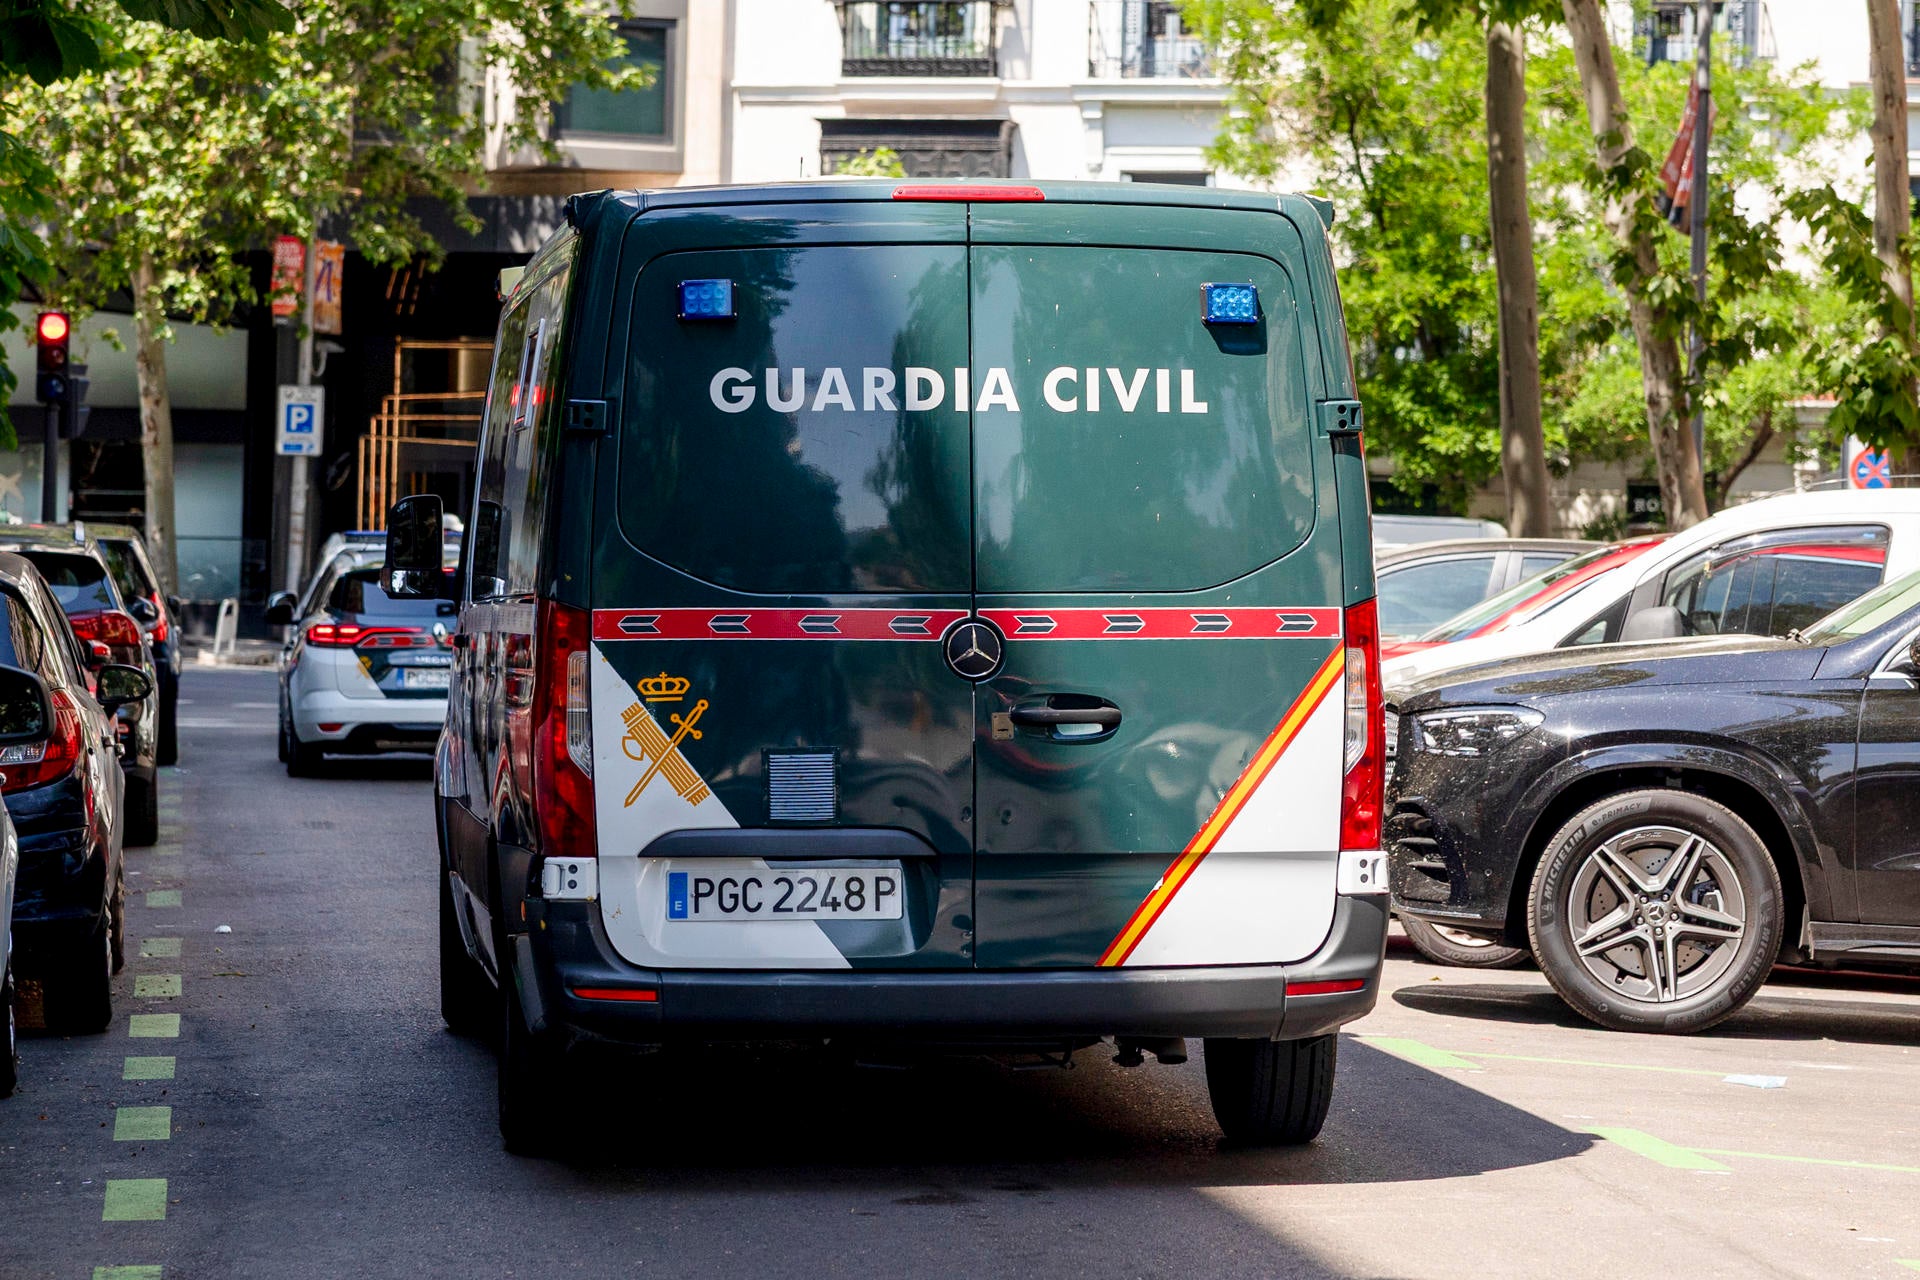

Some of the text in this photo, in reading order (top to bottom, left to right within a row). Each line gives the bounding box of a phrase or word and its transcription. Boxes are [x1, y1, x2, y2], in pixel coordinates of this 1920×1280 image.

[709, 367, 1208, 414] GUARDIA CIVIL
[291, 407, 309, 430] P
[1543, 825, 1586, 900] MICHELIN
[674, 901, 682, 911] E
[693, 876, 896, 914] PGC 2248 P
[1731, 927, 1771, 997] MICHELIN
